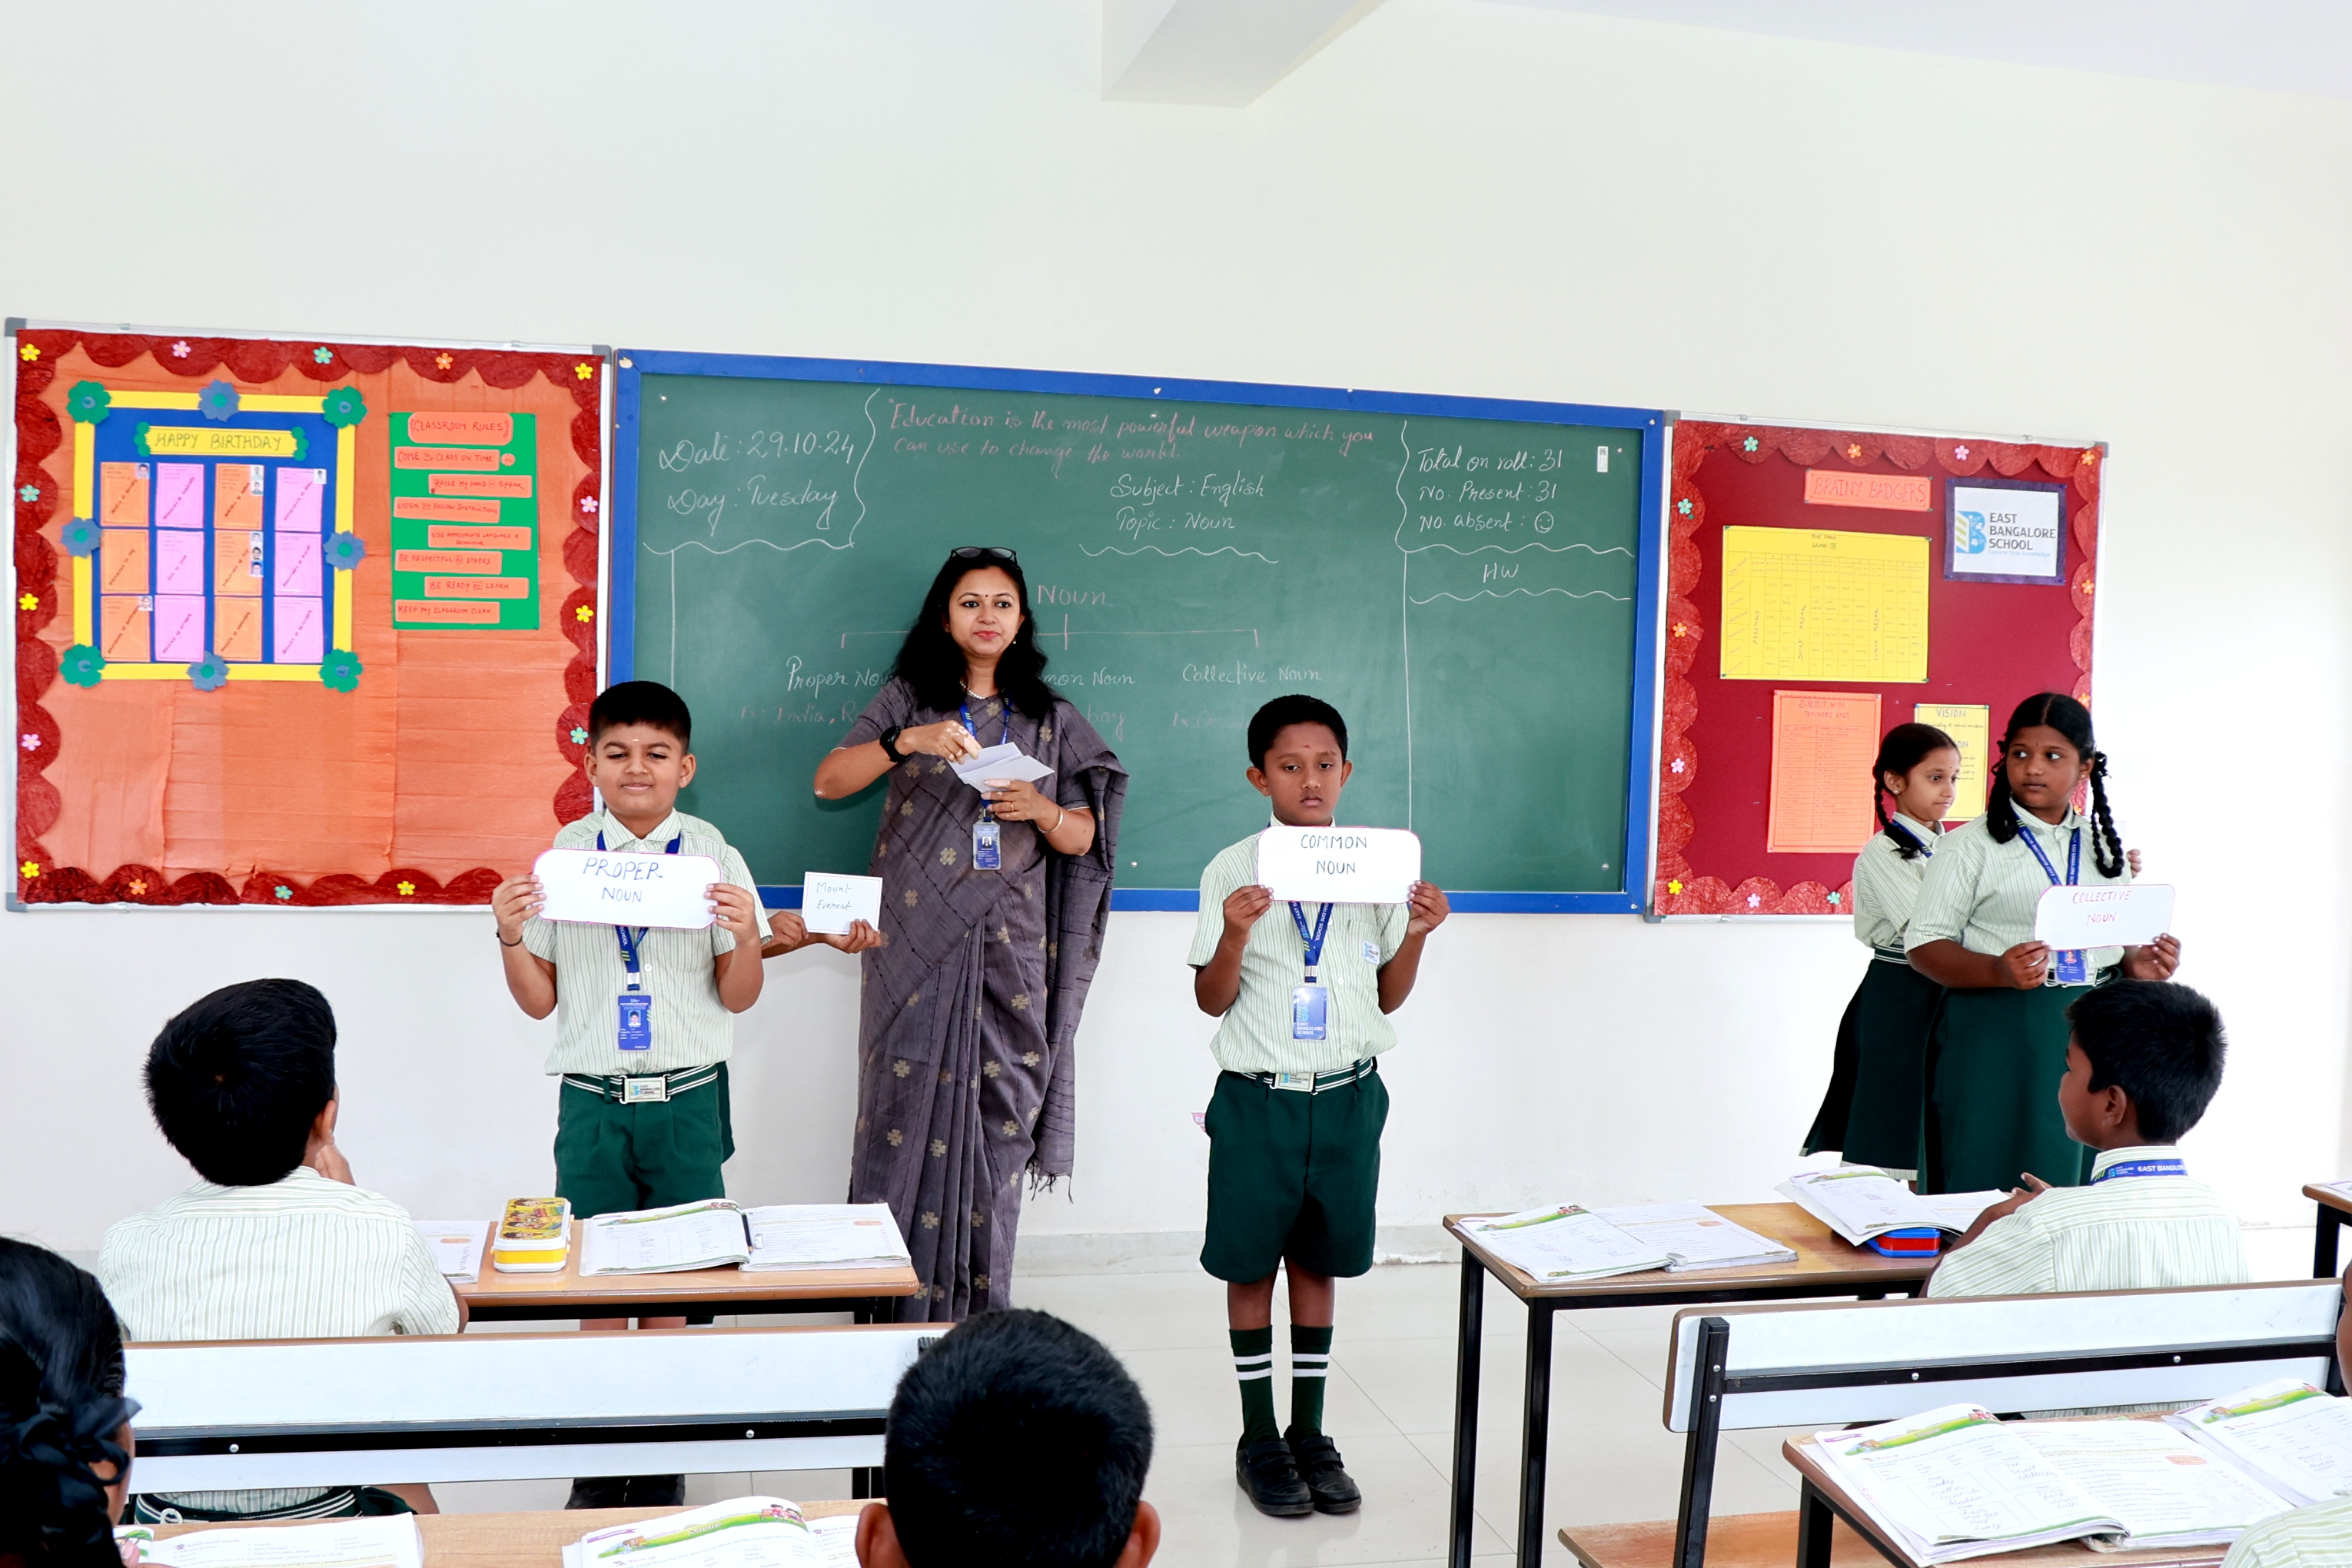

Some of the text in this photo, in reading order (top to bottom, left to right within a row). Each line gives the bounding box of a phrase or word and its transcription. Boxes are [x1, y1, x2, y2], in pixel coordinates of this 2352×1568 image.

[415, 420, 503, 431] CLASSROOM RULES
[1005, 411, 1022, 428] is
[1032, 410, 1054, 430] the
[1062, 415, 1108, 434] most
[1117, 413, 1195, 443] powerful
[1204, 424, 1277, 447] weapon
[1284, 423, 1334, 440] which
[1339, 430, 1373, 457] you
[155, 432, 282, 450] HAPPY BIRTHDAY
[748, 430, 855, 463] 29.10.24
[397, 451, 420, 462] COME
[938, 442, 969, 454] use
[981, 439, 999, 455] to
[1009, 440, 1073, 478] change
[1088, 442, 1110, 463] the
[1418, 444, 1462, 473] Total
[1467, 456, 1490, 470] on
[1539, 448, 1563, 471] 31
[435, 479, 456, 489] RAISE
[1201, 470, 1264, 507] English
[1535, 480, 1557, 502] 31
[1814, 477, 1926, 502] BRAINY BADGERS
[747, 475, 839, 530] Tuesday
[1184, 512, 1235, 530] Noun
[1989, 513, 2018, 524] EAST
[1989, 525, 2056, 538] BANGALORE
[1989, 539, 2033, 550] SCHOOL
[430, 582, 441, 590] BE
[447, 582, 470, 592] READY
[1037, 584, 1113, 606] Noun
[786, 656, 848, 699] Proper
[1092, 667, 1135, 686] Noun
[1182, 660, 1322, 686] Collective Noun
[1936, 708, 1966, 718] VISION
[1301, 834, 1367, 849] COMMON
[583, 857, 663, 881] PROPER
[1316, 860, 1356, 875] NOUN
[601, 886, 643, 903] NOUN
[816, 882, 852, 893] Mount
[816, 899, 852, 911] Everest
[2072, 890, 2133, 905] COLLECTIVE
[2086, 912, 2118, 926] NOUN
[688, 1523, 723, 1536] Nouns
